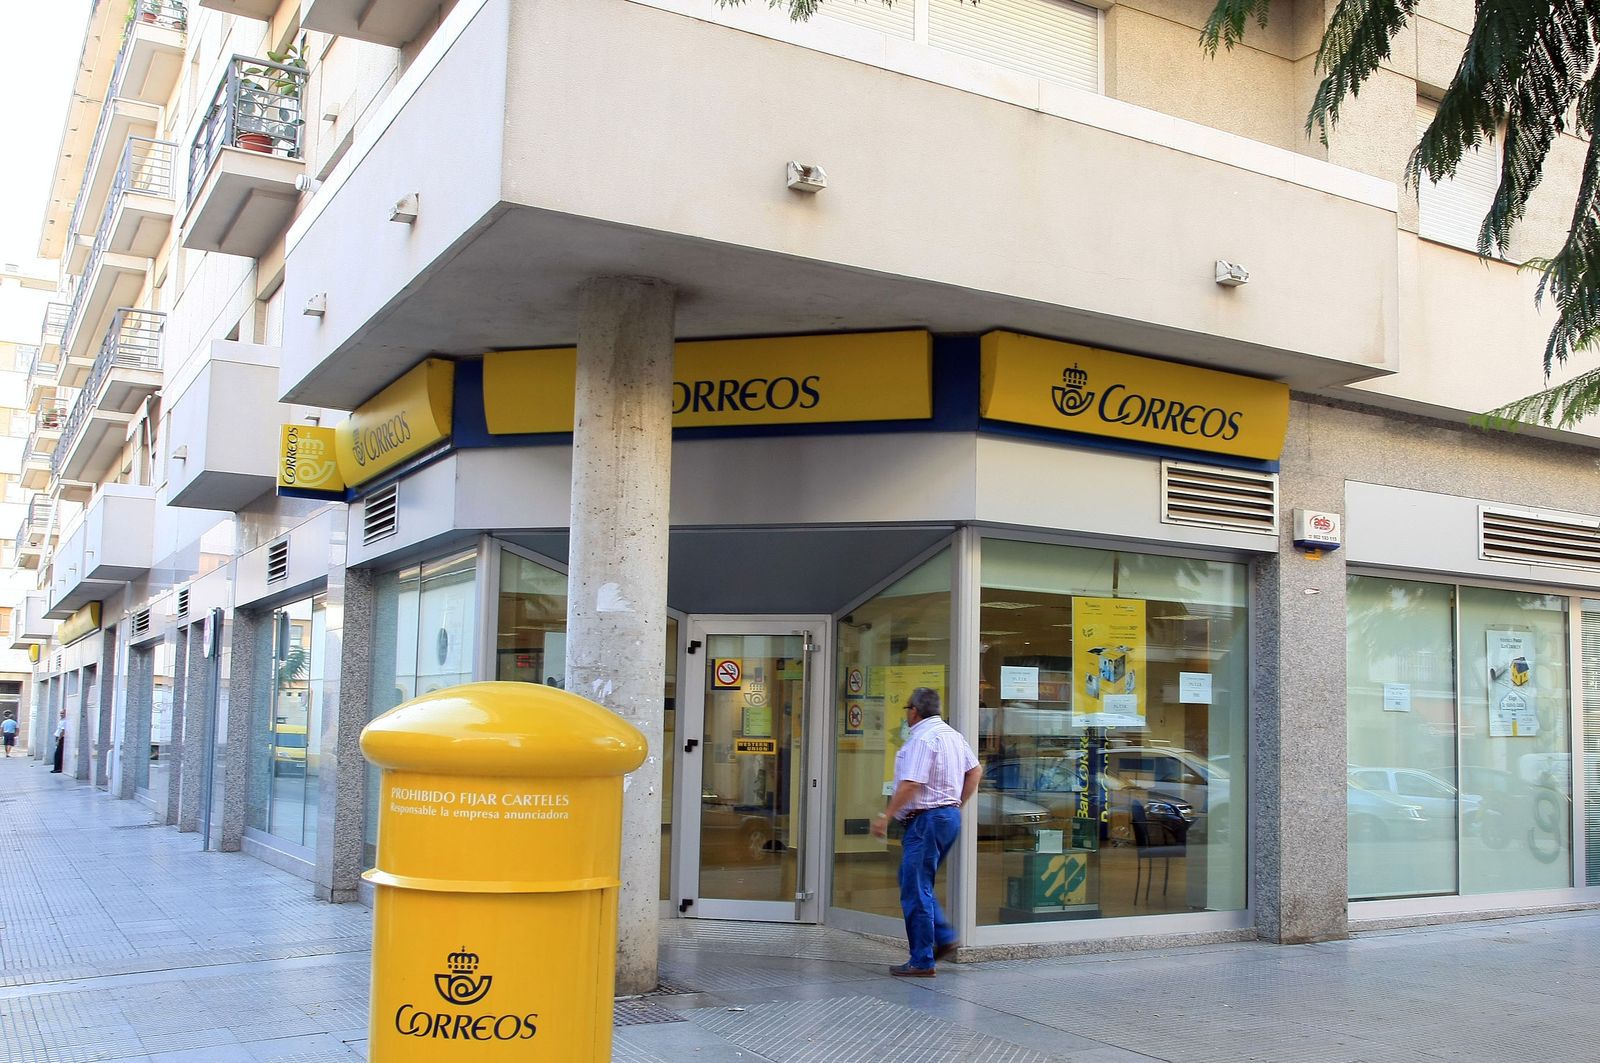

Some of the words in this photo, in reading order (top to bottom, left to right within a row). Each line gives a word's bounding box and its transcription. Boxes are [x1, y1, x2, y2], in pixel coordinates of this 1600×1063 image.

[672, 375, 820, 414] ORREOS
[1098, 384, 1243, 441] CORREOS
[282, 426, 299, 485] CORREOS
[363, 411, 412, 461] CORREOS
[391, 787, 456, 804] PROHIBIDO
[460, 792, 497, 806] FIJAR
[502, 793, 569, 806] CARTELES
[391, 803, 437, 816] Responsable
[440, 806, 449, 817] la
[453, 809, 500, 821] empresa
[503, 809, 569, 820] anunciadora
[395, 1003, 538, 1041] CORREOS
